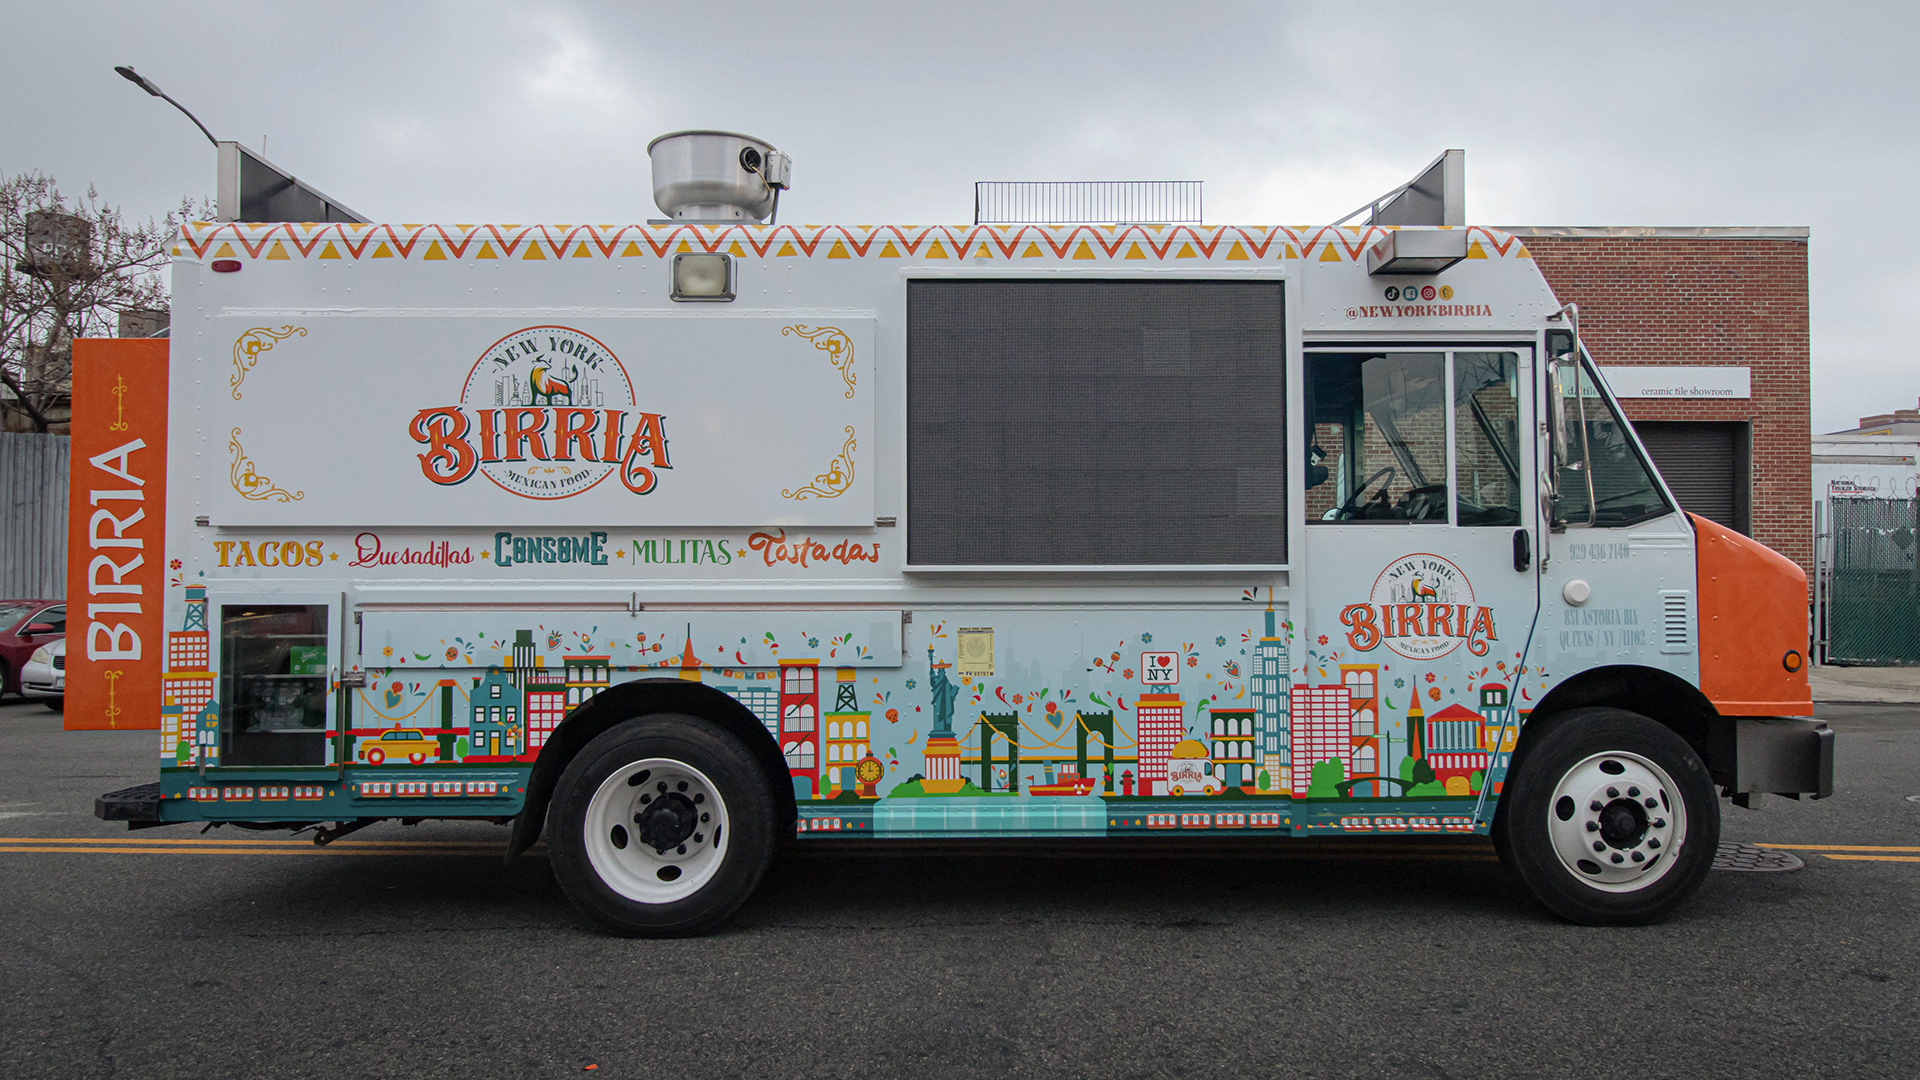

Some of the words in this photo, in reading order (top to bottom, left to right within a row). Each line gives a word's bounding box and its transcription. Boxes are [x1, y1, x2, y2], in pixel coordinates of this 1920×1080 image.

[1345, 304, 1492, 320] @NEWYORKBIRRIA
[1641, 387, 1673, 396] ceramic
[1675, 386, 1688, 396] tile
[1689, 387, 1733, 396] showroom
[408, 406, 673, 495] BIRRIA
[505, 469, 557, 490] MEXICAN
[560, 468, 590, 489] FOOD
[87, 437, 147, 662] BIRRIA
[213, 540, 324, 568] TACOS
[348, 531, 474, 569] Quesadillas
[632, 538, 732, 566] MULITAS
[748, 528, 882, 569] Tostadas
[1569, 543, 1587, 560] 929
[1588, 543, 1606, 560] 436
[1609, 543, 1630, 560] 7140
[1564, 609, 1579, 626] 851
[1581, 609, 1621, 625] ASTORIA
[1339, 602, 1499, 657] BIRRIA
[1399, 641, 1430, 655] MEXICAN
[1559, 630, 1594, 650] QUEENS
[1603, 630, 1615, 646] NY
[1147, 668, 1173, 680] NY
[1170, 771, 1203, 783] BIRRIA
